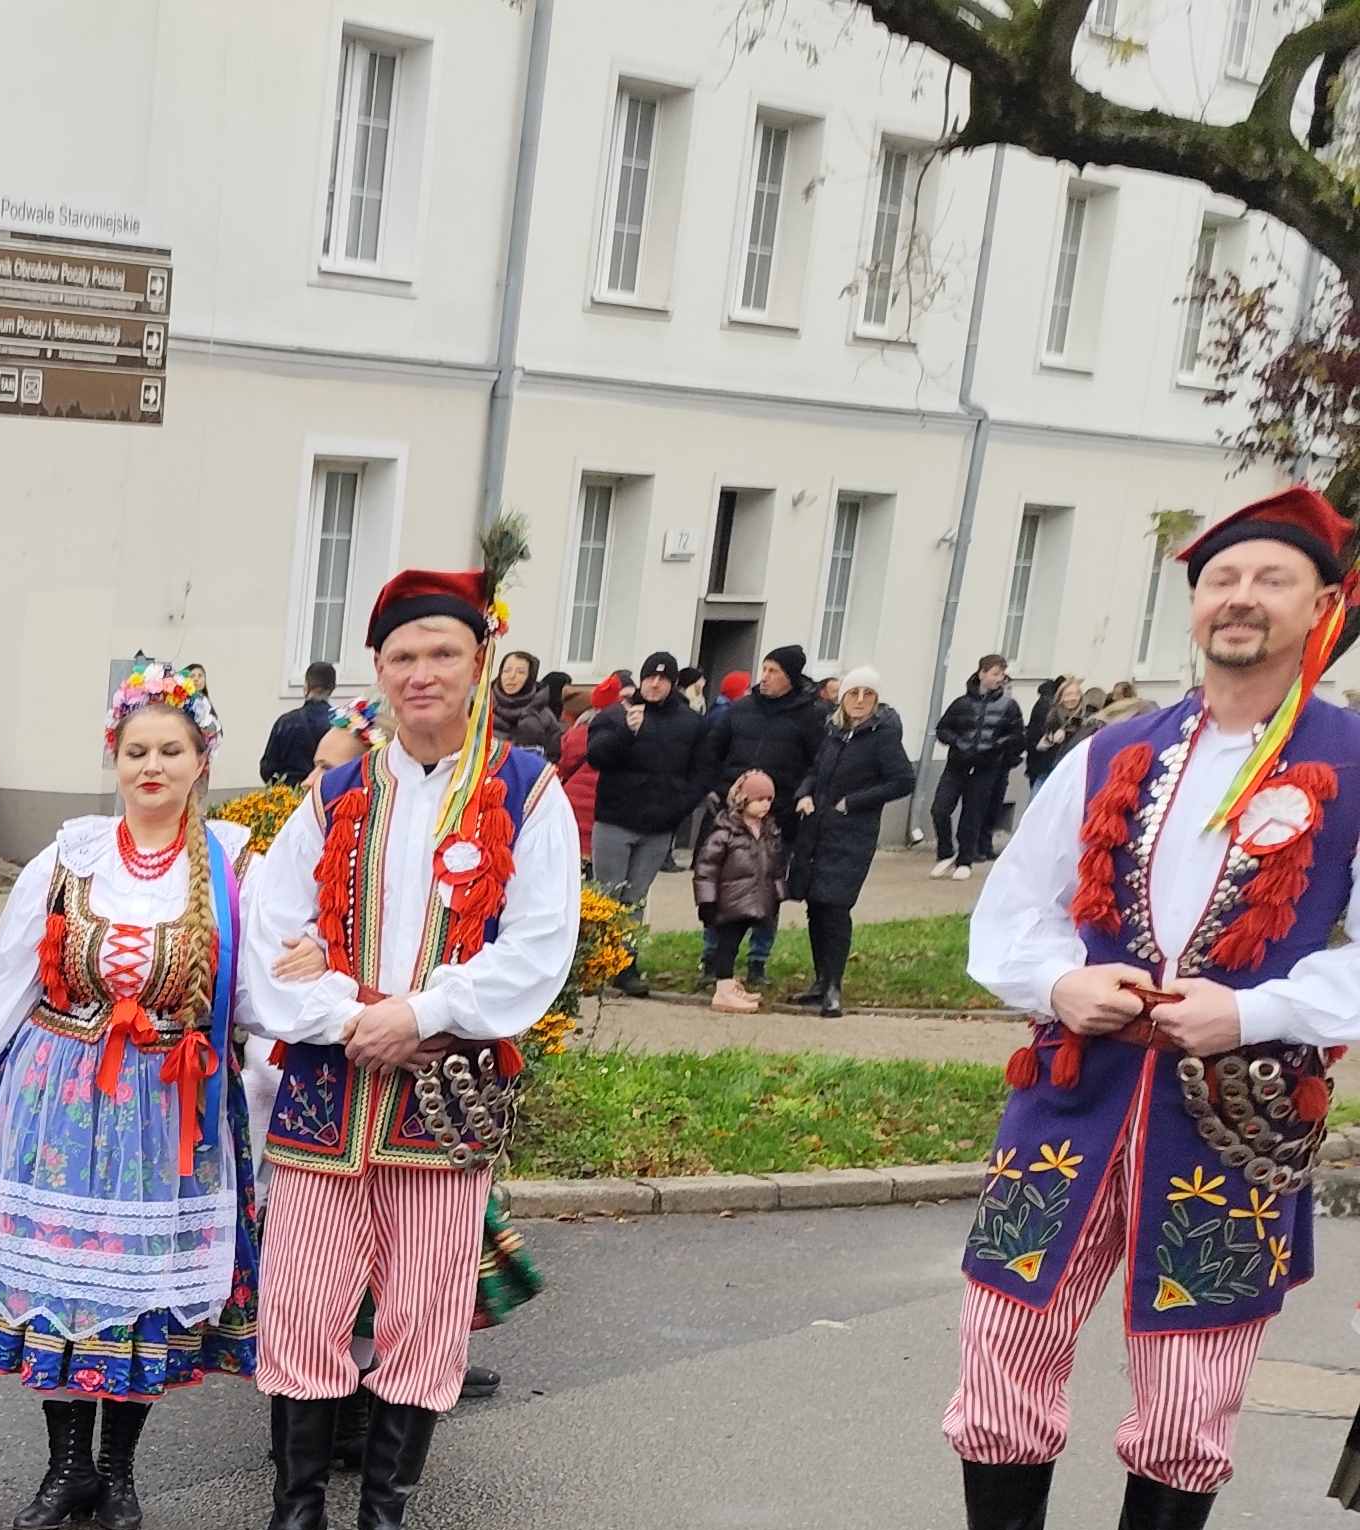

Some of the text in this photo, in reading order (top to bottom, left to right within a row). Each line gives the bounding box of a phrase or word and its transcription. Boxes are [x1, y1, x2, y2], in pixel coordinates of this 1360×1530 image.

[1, 197, 55, 225] Podwale
[59, 205, 141, 237] Staromiejskie
[16, 315, 47, 341] Poczty
